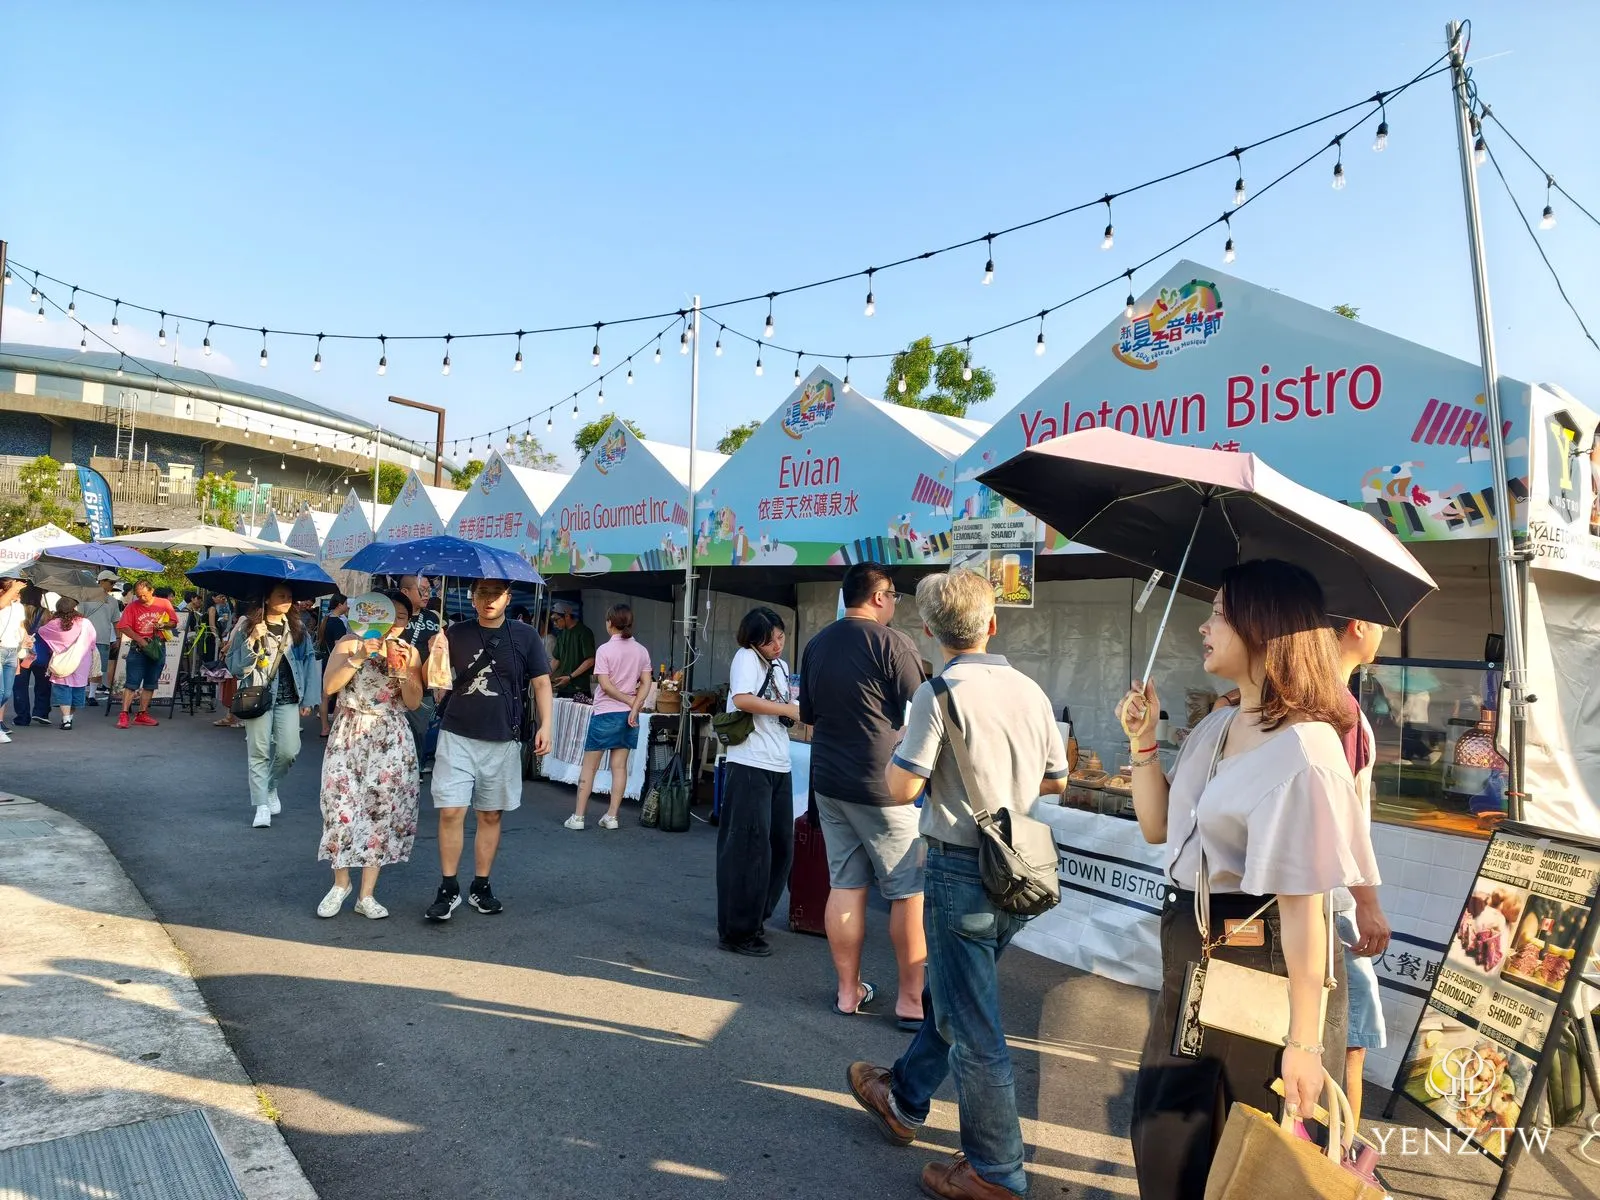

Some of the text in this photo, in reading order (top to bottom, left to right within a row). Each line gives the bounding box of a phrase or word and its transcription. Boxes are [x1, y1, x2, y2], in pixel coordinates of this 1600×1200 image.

[1226, 364, 1382, 430] Bistro
[779, 449, 840, 489] Evian
[560, 496, 670, 533] Orilia Gourmet Inc.
[758, 489, 859, 521] 依雲天然礦泉水
[990, 530, 1017, 539] SHANDY
[1007, 521, 1024, 529] LEMON
[1510, 852, 1535, 866] MASHED
[1539, 858, 1593, 880] SMOKED MEAT
[1542, 848, 1581, 866] MONTREAL
[1111, 870, 1166, 901] BISTRO
[1535, 869, 1574, 888] SANDWICH
[1434, 980, 1477, 1009] LEMONADE
[1492, 991, 1545, 1024] BUTTER GARLIC
[1487, 1005, 1523, 1030] SHRIMP
